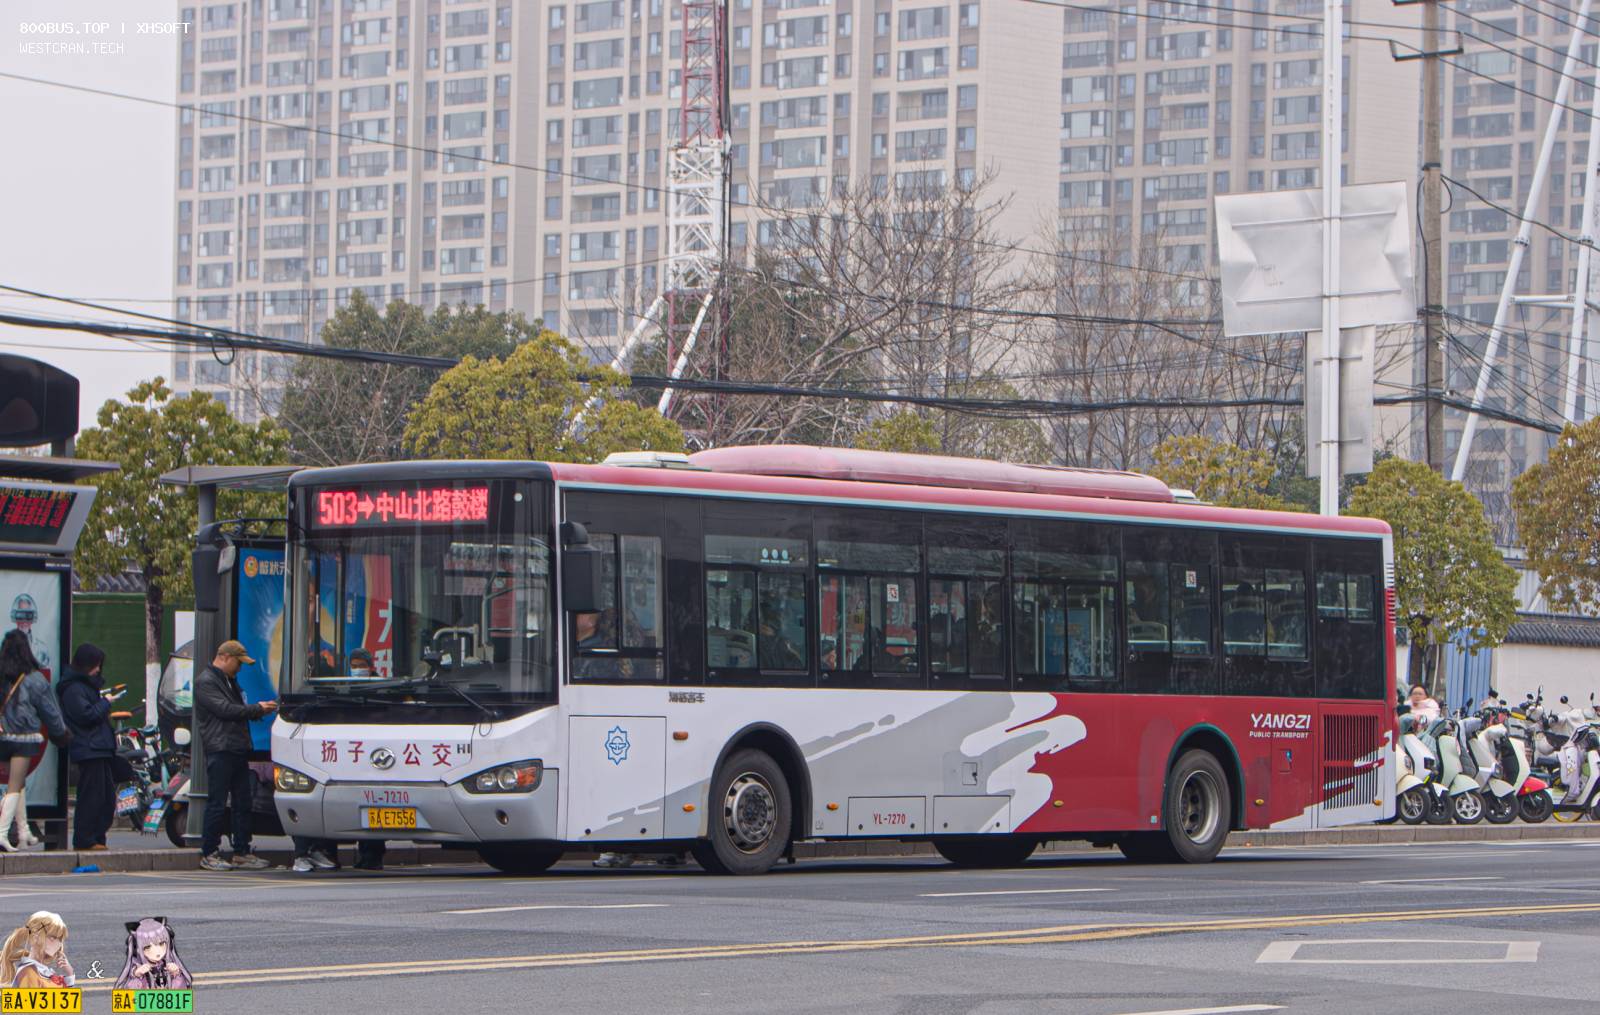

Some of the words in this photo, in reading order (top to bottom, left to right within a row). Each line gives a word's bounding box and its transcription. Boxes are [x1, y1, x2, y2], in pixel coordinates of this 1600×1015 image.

[319, 491, 358, 525] 503
[375, 487, 489, 522] 中山北路鼓楼
[1251, 713, 1311, 728] YANGZI
[363, 790, 409, 804] YL-7270
[873, 813, 905, 825] YL-7270
